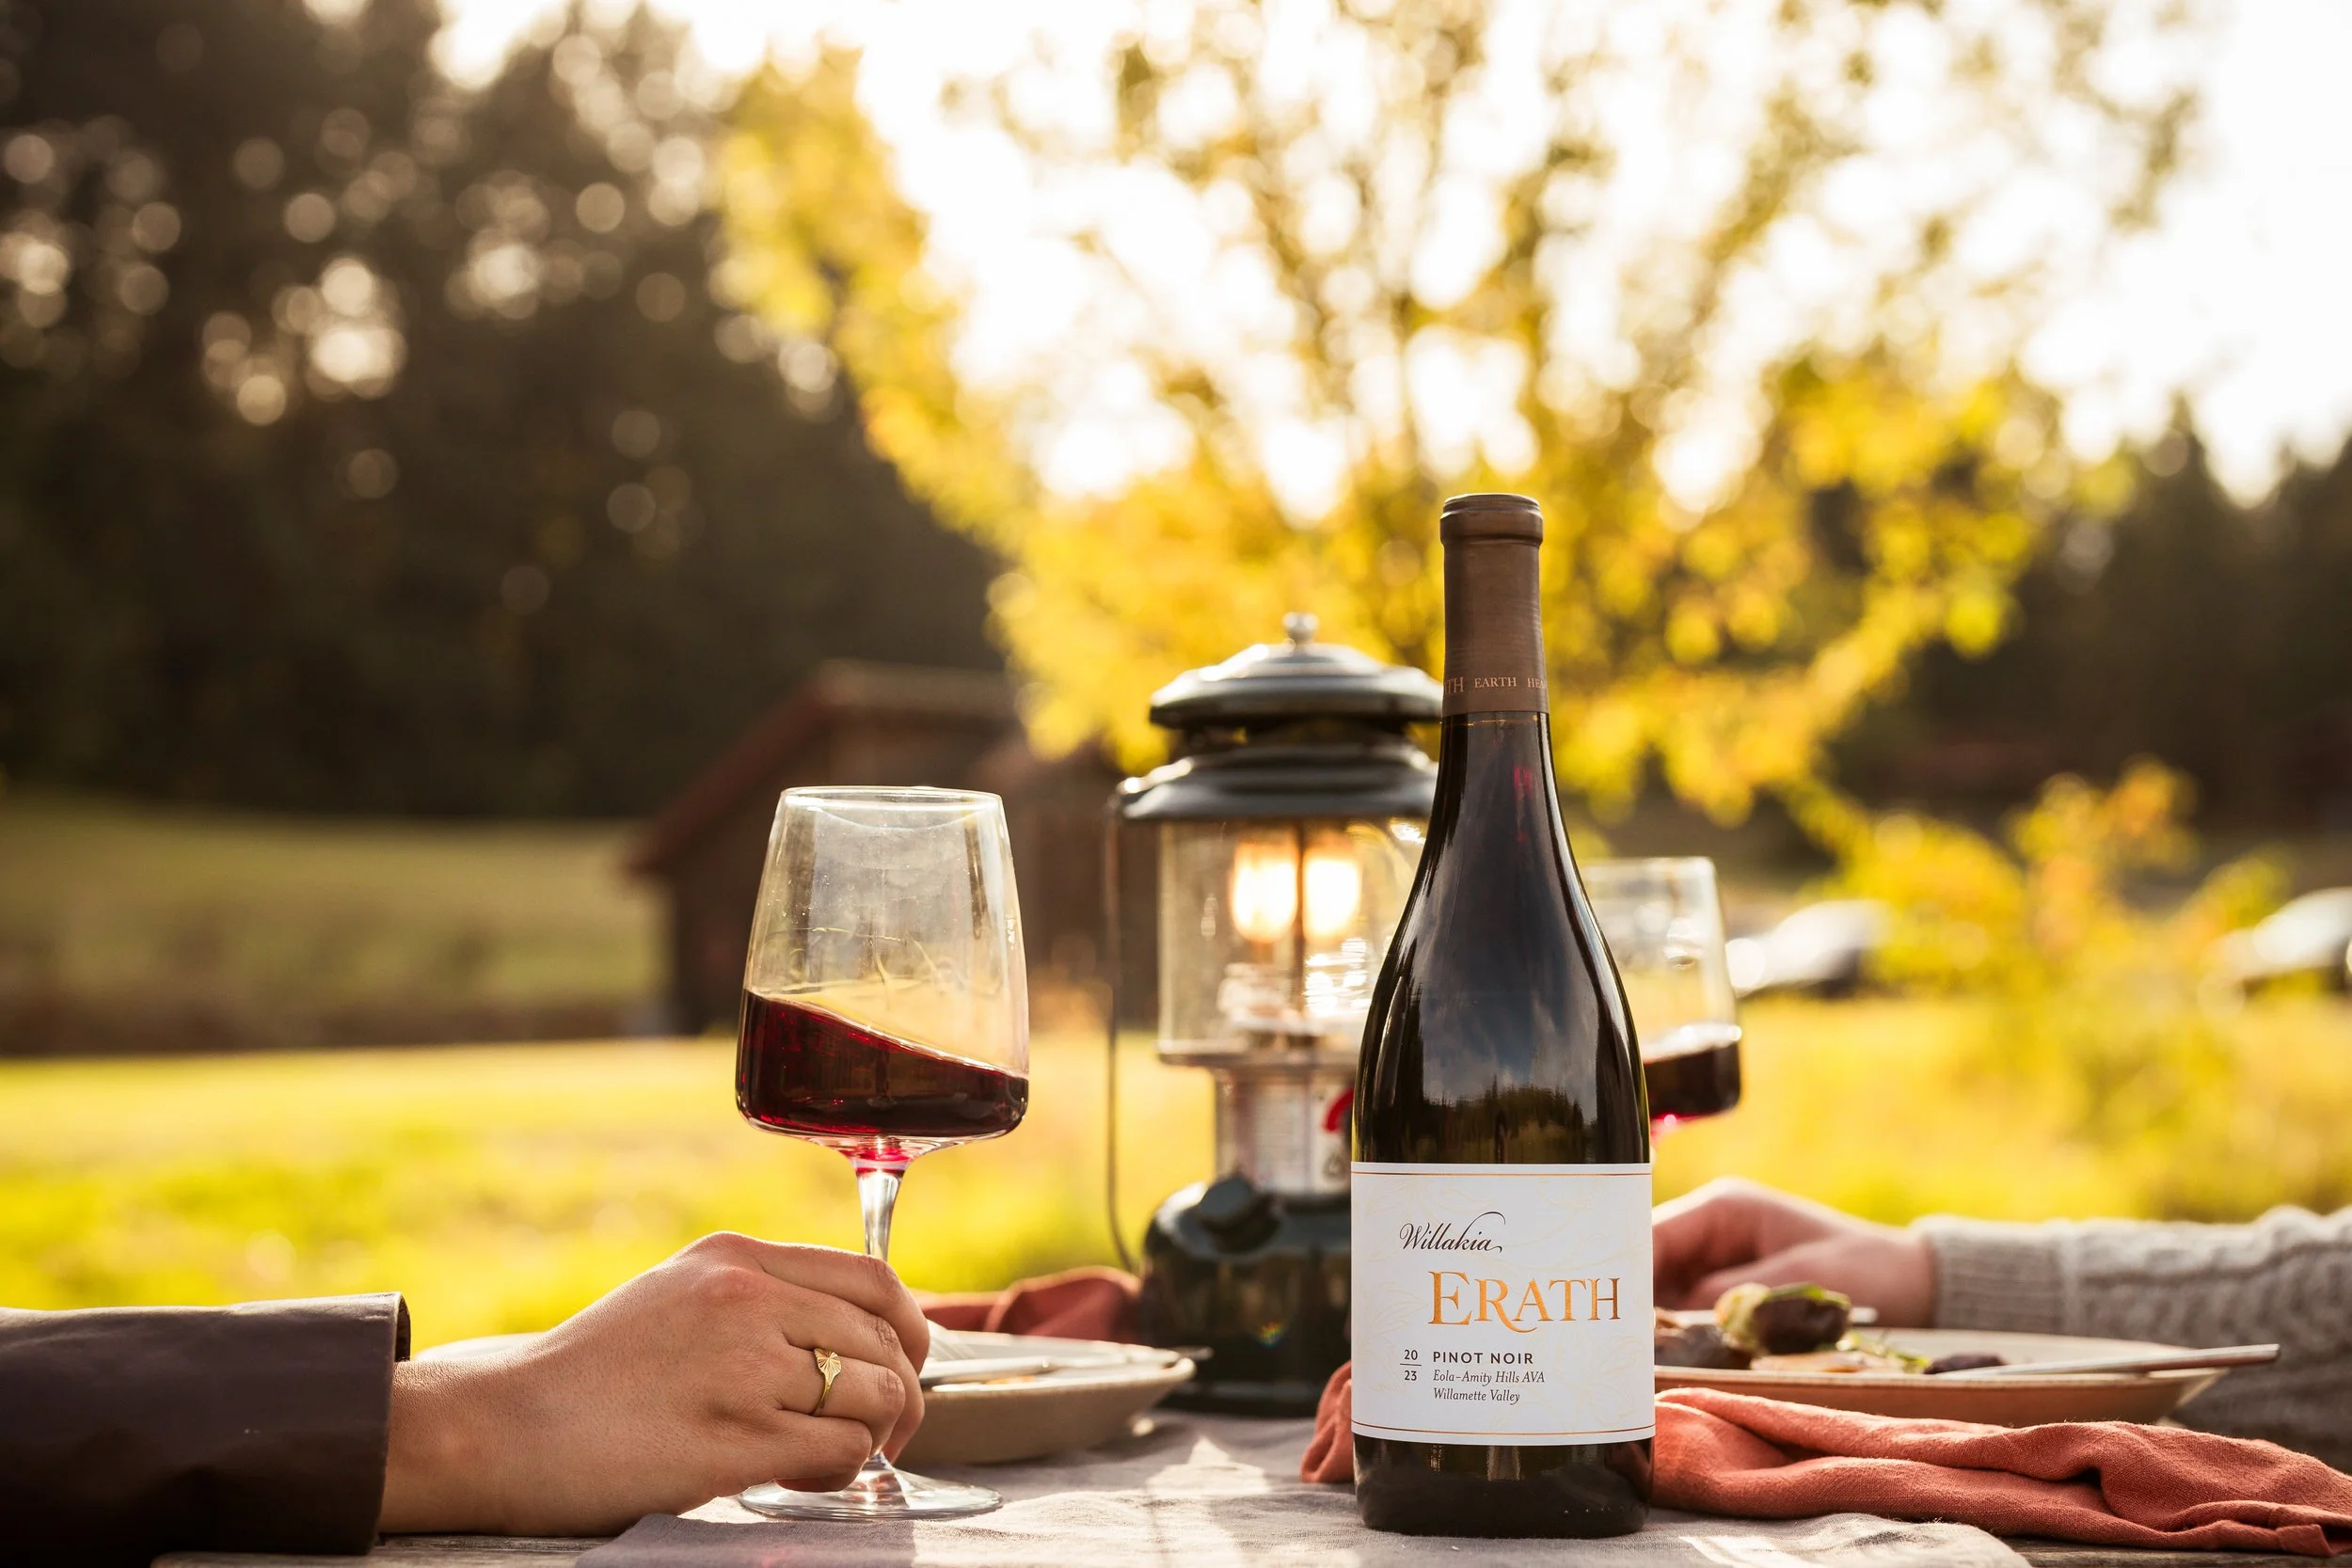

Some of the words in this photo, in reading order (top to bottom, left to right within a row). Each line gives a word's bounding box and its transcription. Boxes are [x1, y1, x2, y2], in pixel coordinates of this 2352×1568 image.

[1444, 676, 1465, 695] TH
[1474, 676, 1517, 689] EARTH
[1399, 1211, 1506, 1254] Willakia
[1427, 1271, 1621, 1334] ERATH
[1404, 1349, 1419, 1361] 20
[1433, 1351, 1484, 1364] PINOT
[1490, 1353, 1534, 1365] NOIR
[1404, 1370, 1418, 1382] 23
[1433, 1369, 1492, 1387] Eola-Amity
[1495, 1370, 1520, 1384] Hills
[1521, 1371, 1546, 1384] AVA
[1433, 1387, 1486, 1402] Willamette
[1489, 1388, 1520, 1406] Valley
